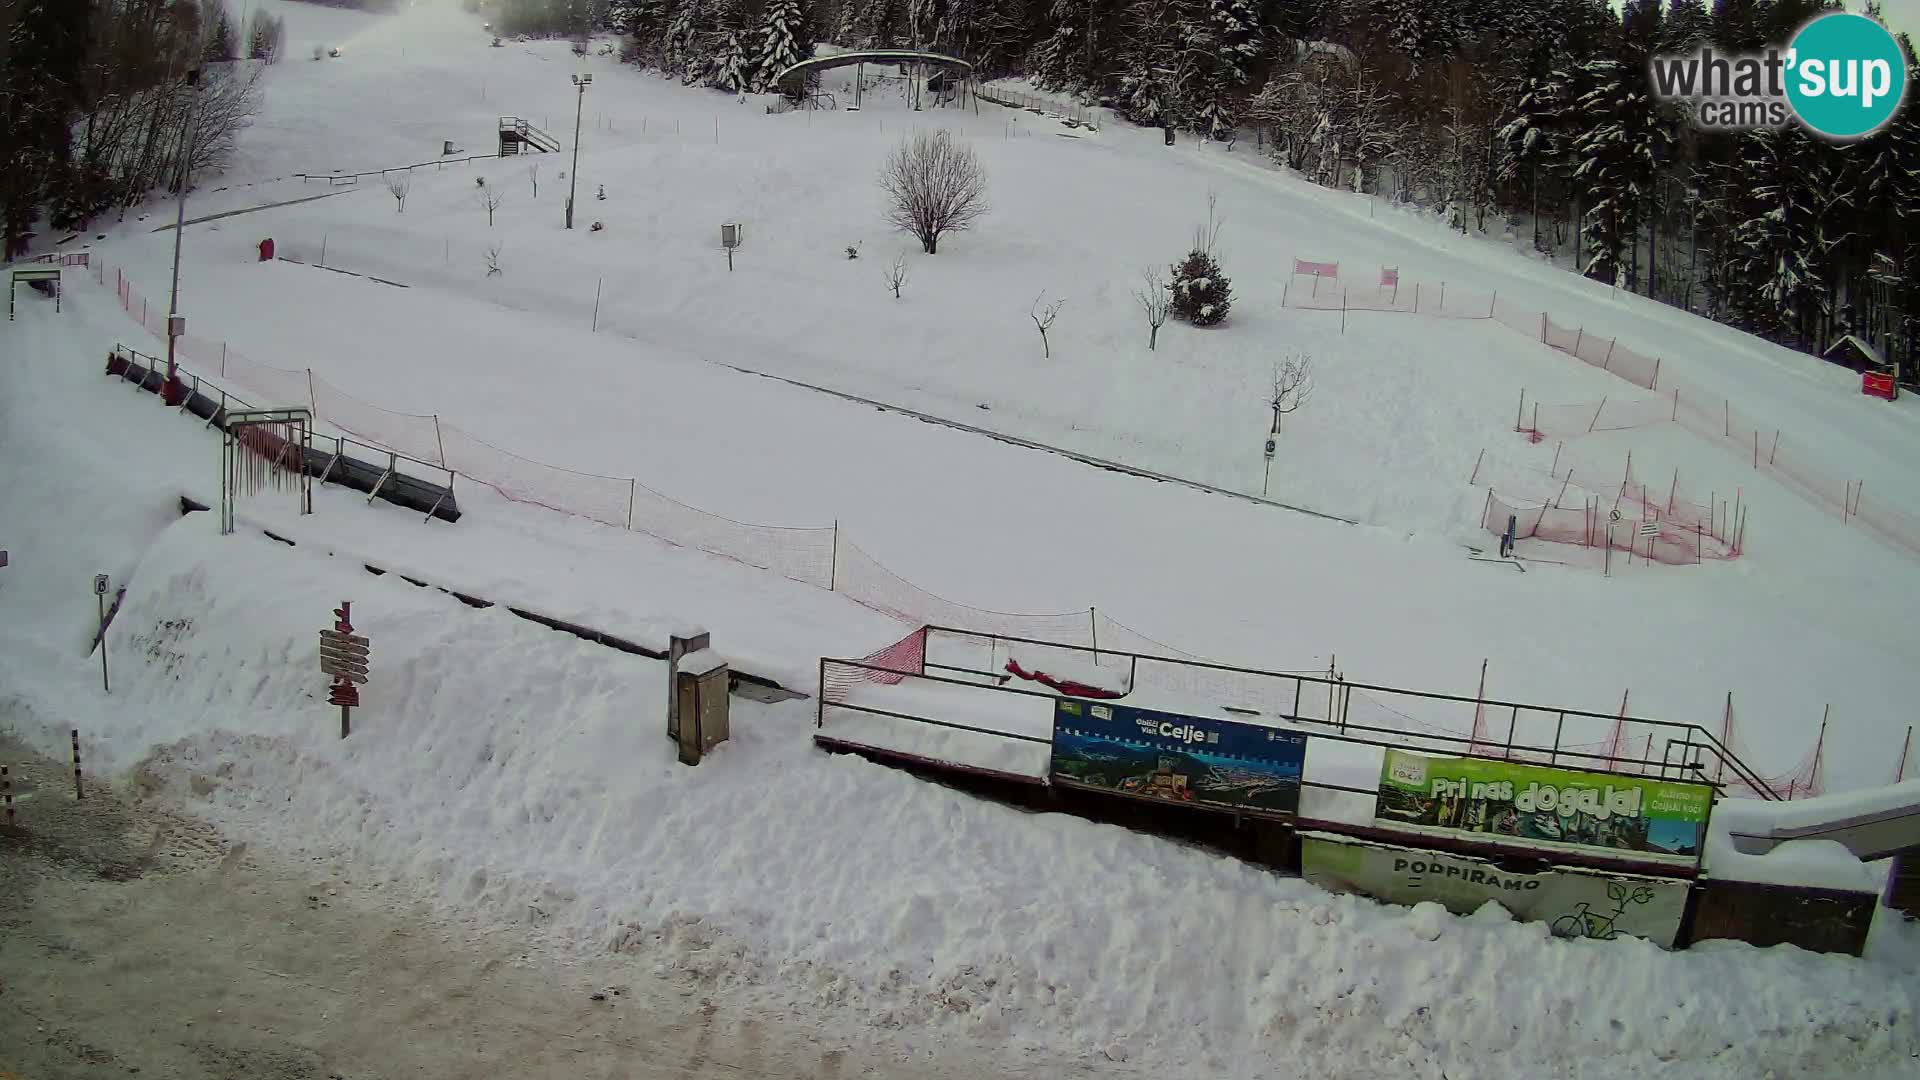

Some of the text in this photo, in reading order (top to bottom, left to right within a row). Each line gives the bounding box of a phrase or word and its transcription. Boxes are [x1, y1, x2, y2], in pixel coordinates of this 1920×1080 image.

[1160, 722, 1205, 744] Celje
[1430, 777, 1642, 820] Pri nas dogaja!
[1394, 858, 1541, 891] PODPIRAMO
